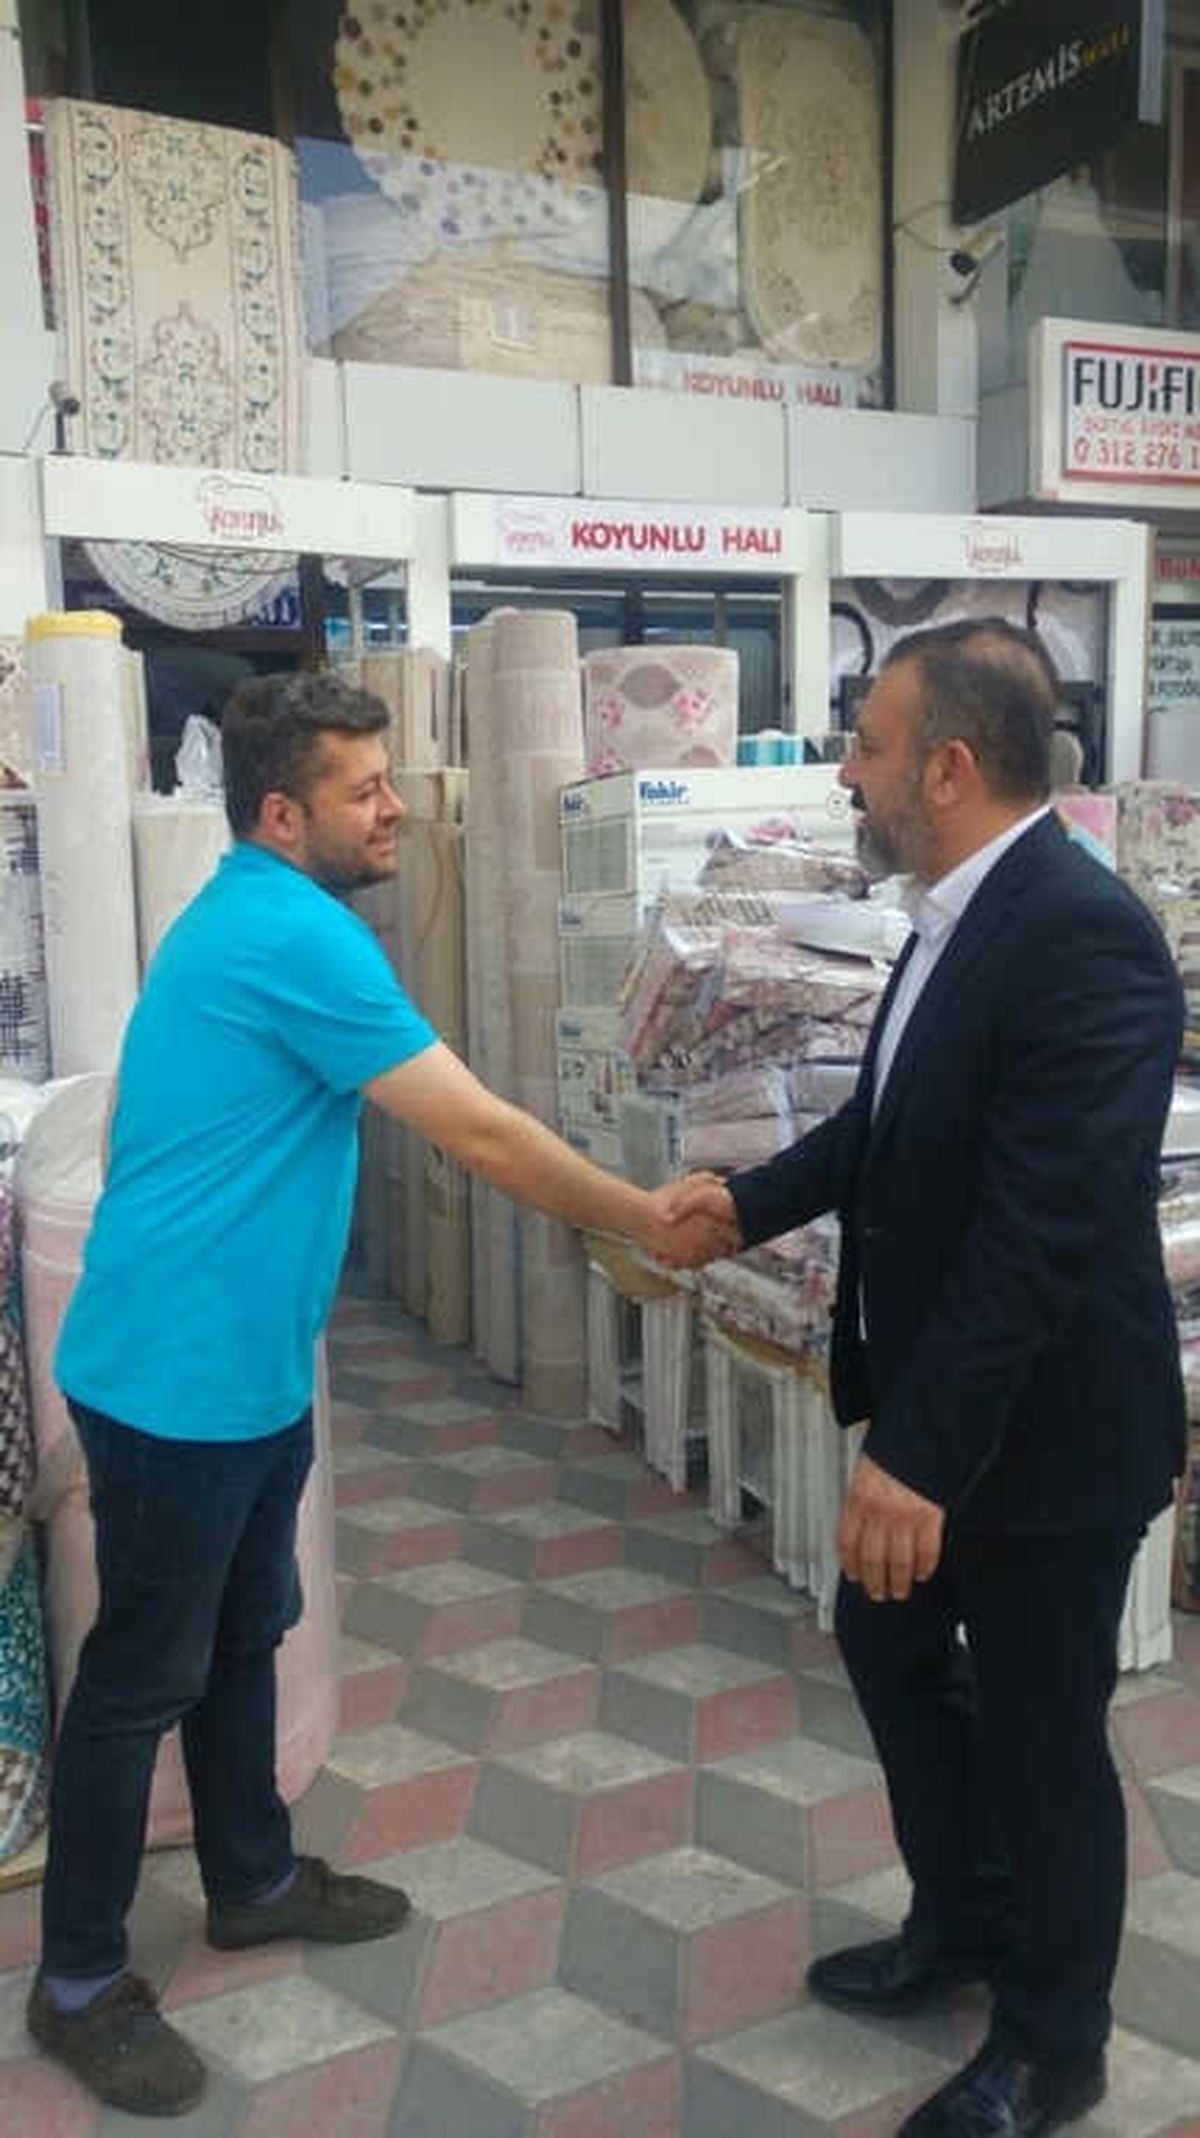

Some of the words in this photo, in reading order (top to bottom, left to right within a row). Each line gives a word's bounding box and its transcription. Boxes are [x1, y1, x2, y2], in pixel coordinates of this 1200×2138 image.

[682, 371, 784, 402] KOYUNLU
[571, 522, 706, 552] KOYUNLU
[721, 527, 783, 554] HALI
